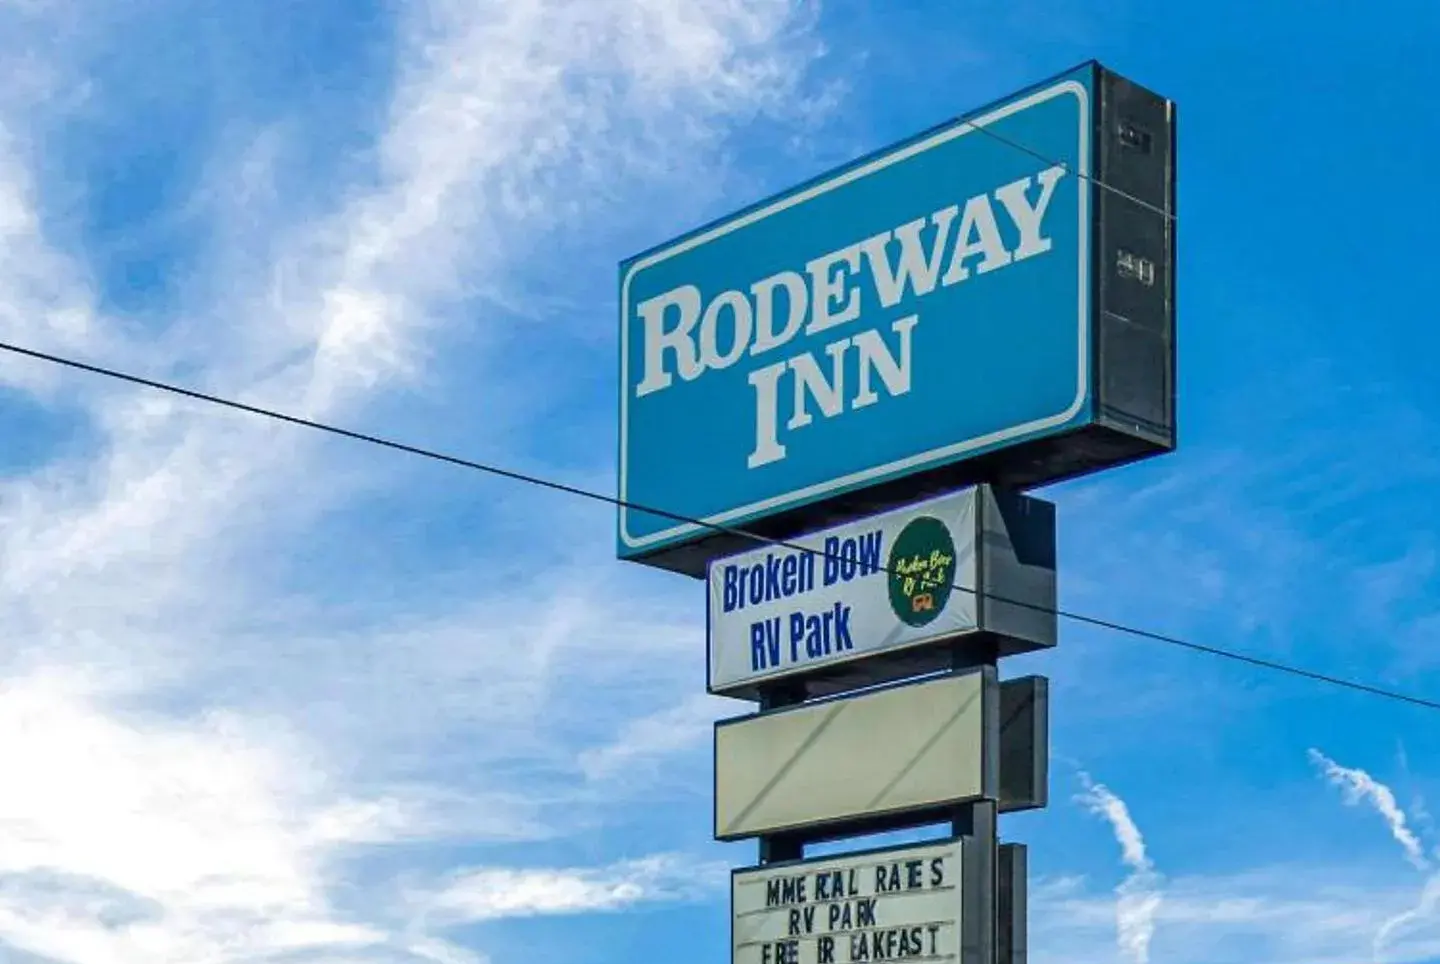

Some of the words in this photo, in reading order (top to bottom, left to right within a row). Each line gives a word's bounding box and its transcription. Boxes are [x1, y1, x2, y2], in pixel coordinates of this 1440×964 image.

[636, 163, 1069, 397] RODEWAY
[747, 315, 919, 469] INN
[723, 552, 815, 613] Broken
[750, 618, 781, 671] RV
[790, 602, 854, 662] Park
[788, 905, 815, 936] RV
